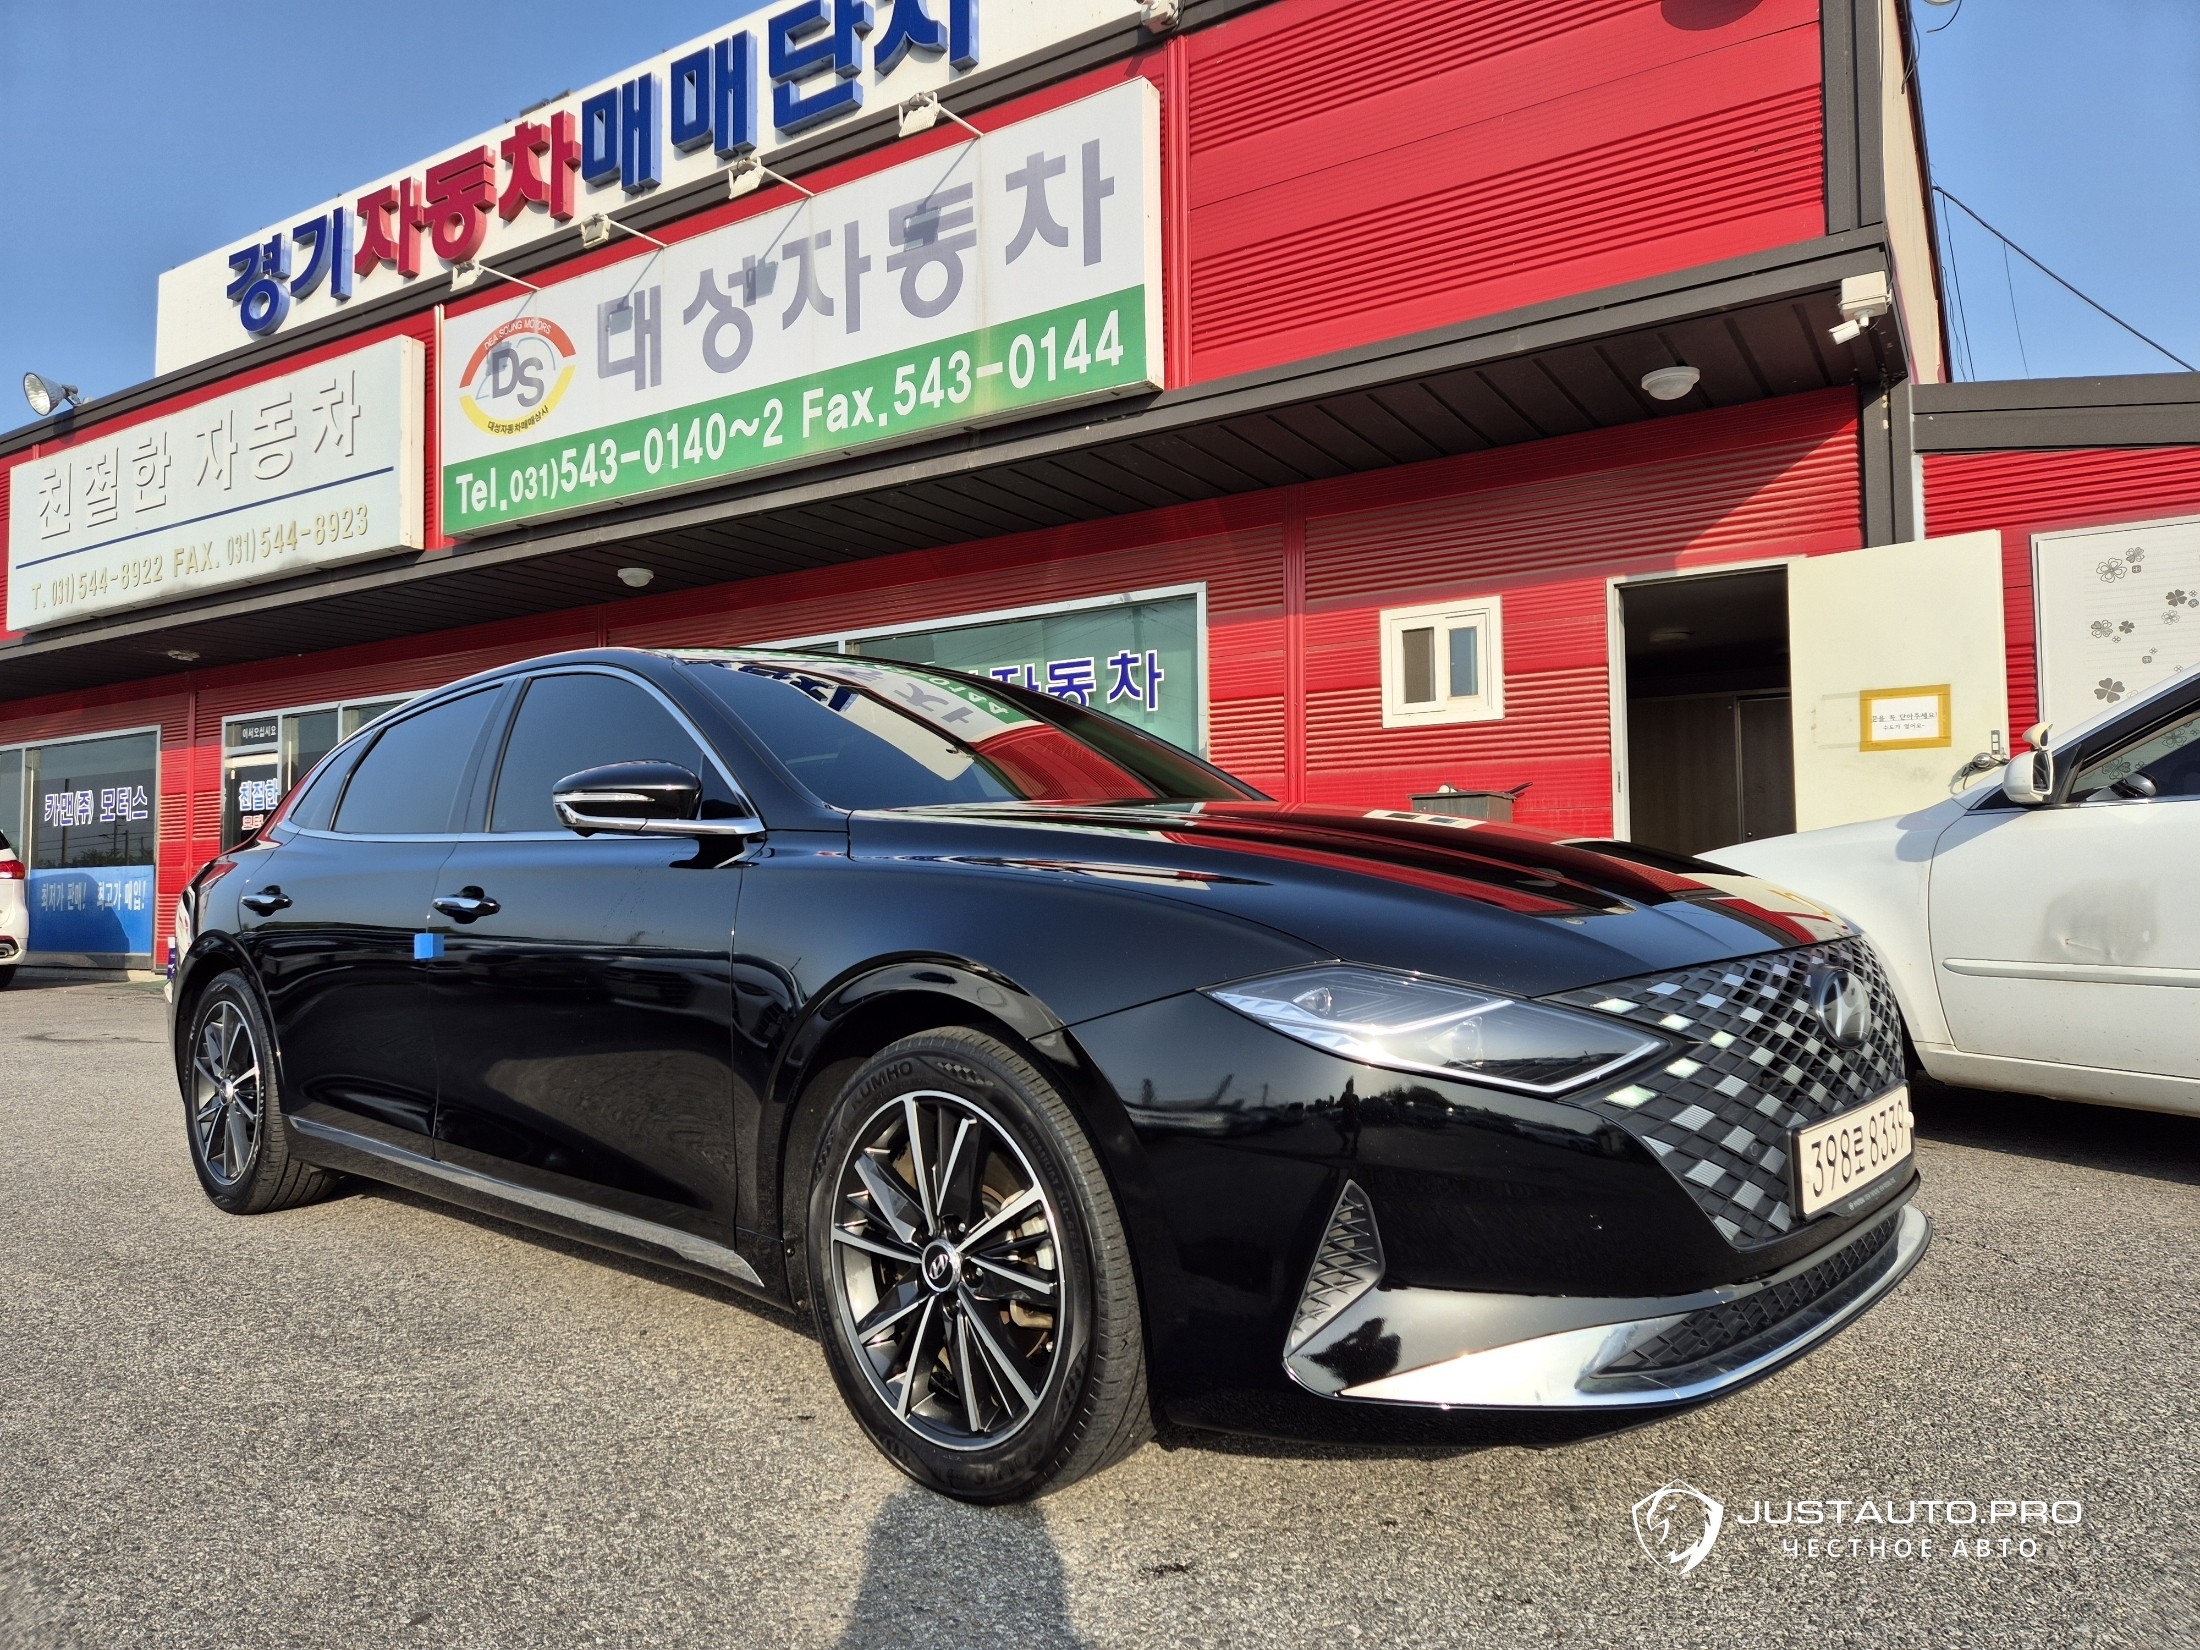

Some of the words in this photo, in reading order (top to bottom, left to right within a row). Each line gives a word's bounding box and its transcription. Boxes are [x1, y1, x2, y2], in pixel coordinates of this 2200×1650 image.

[597, 138, 1114, 392] 대성자동차
[492, 347, 545, 408] DS
[38, 430, 172, 540] 친절한
[193, 369, 361, 492] 자동차
[173, 541, 220, 577] FAX.
